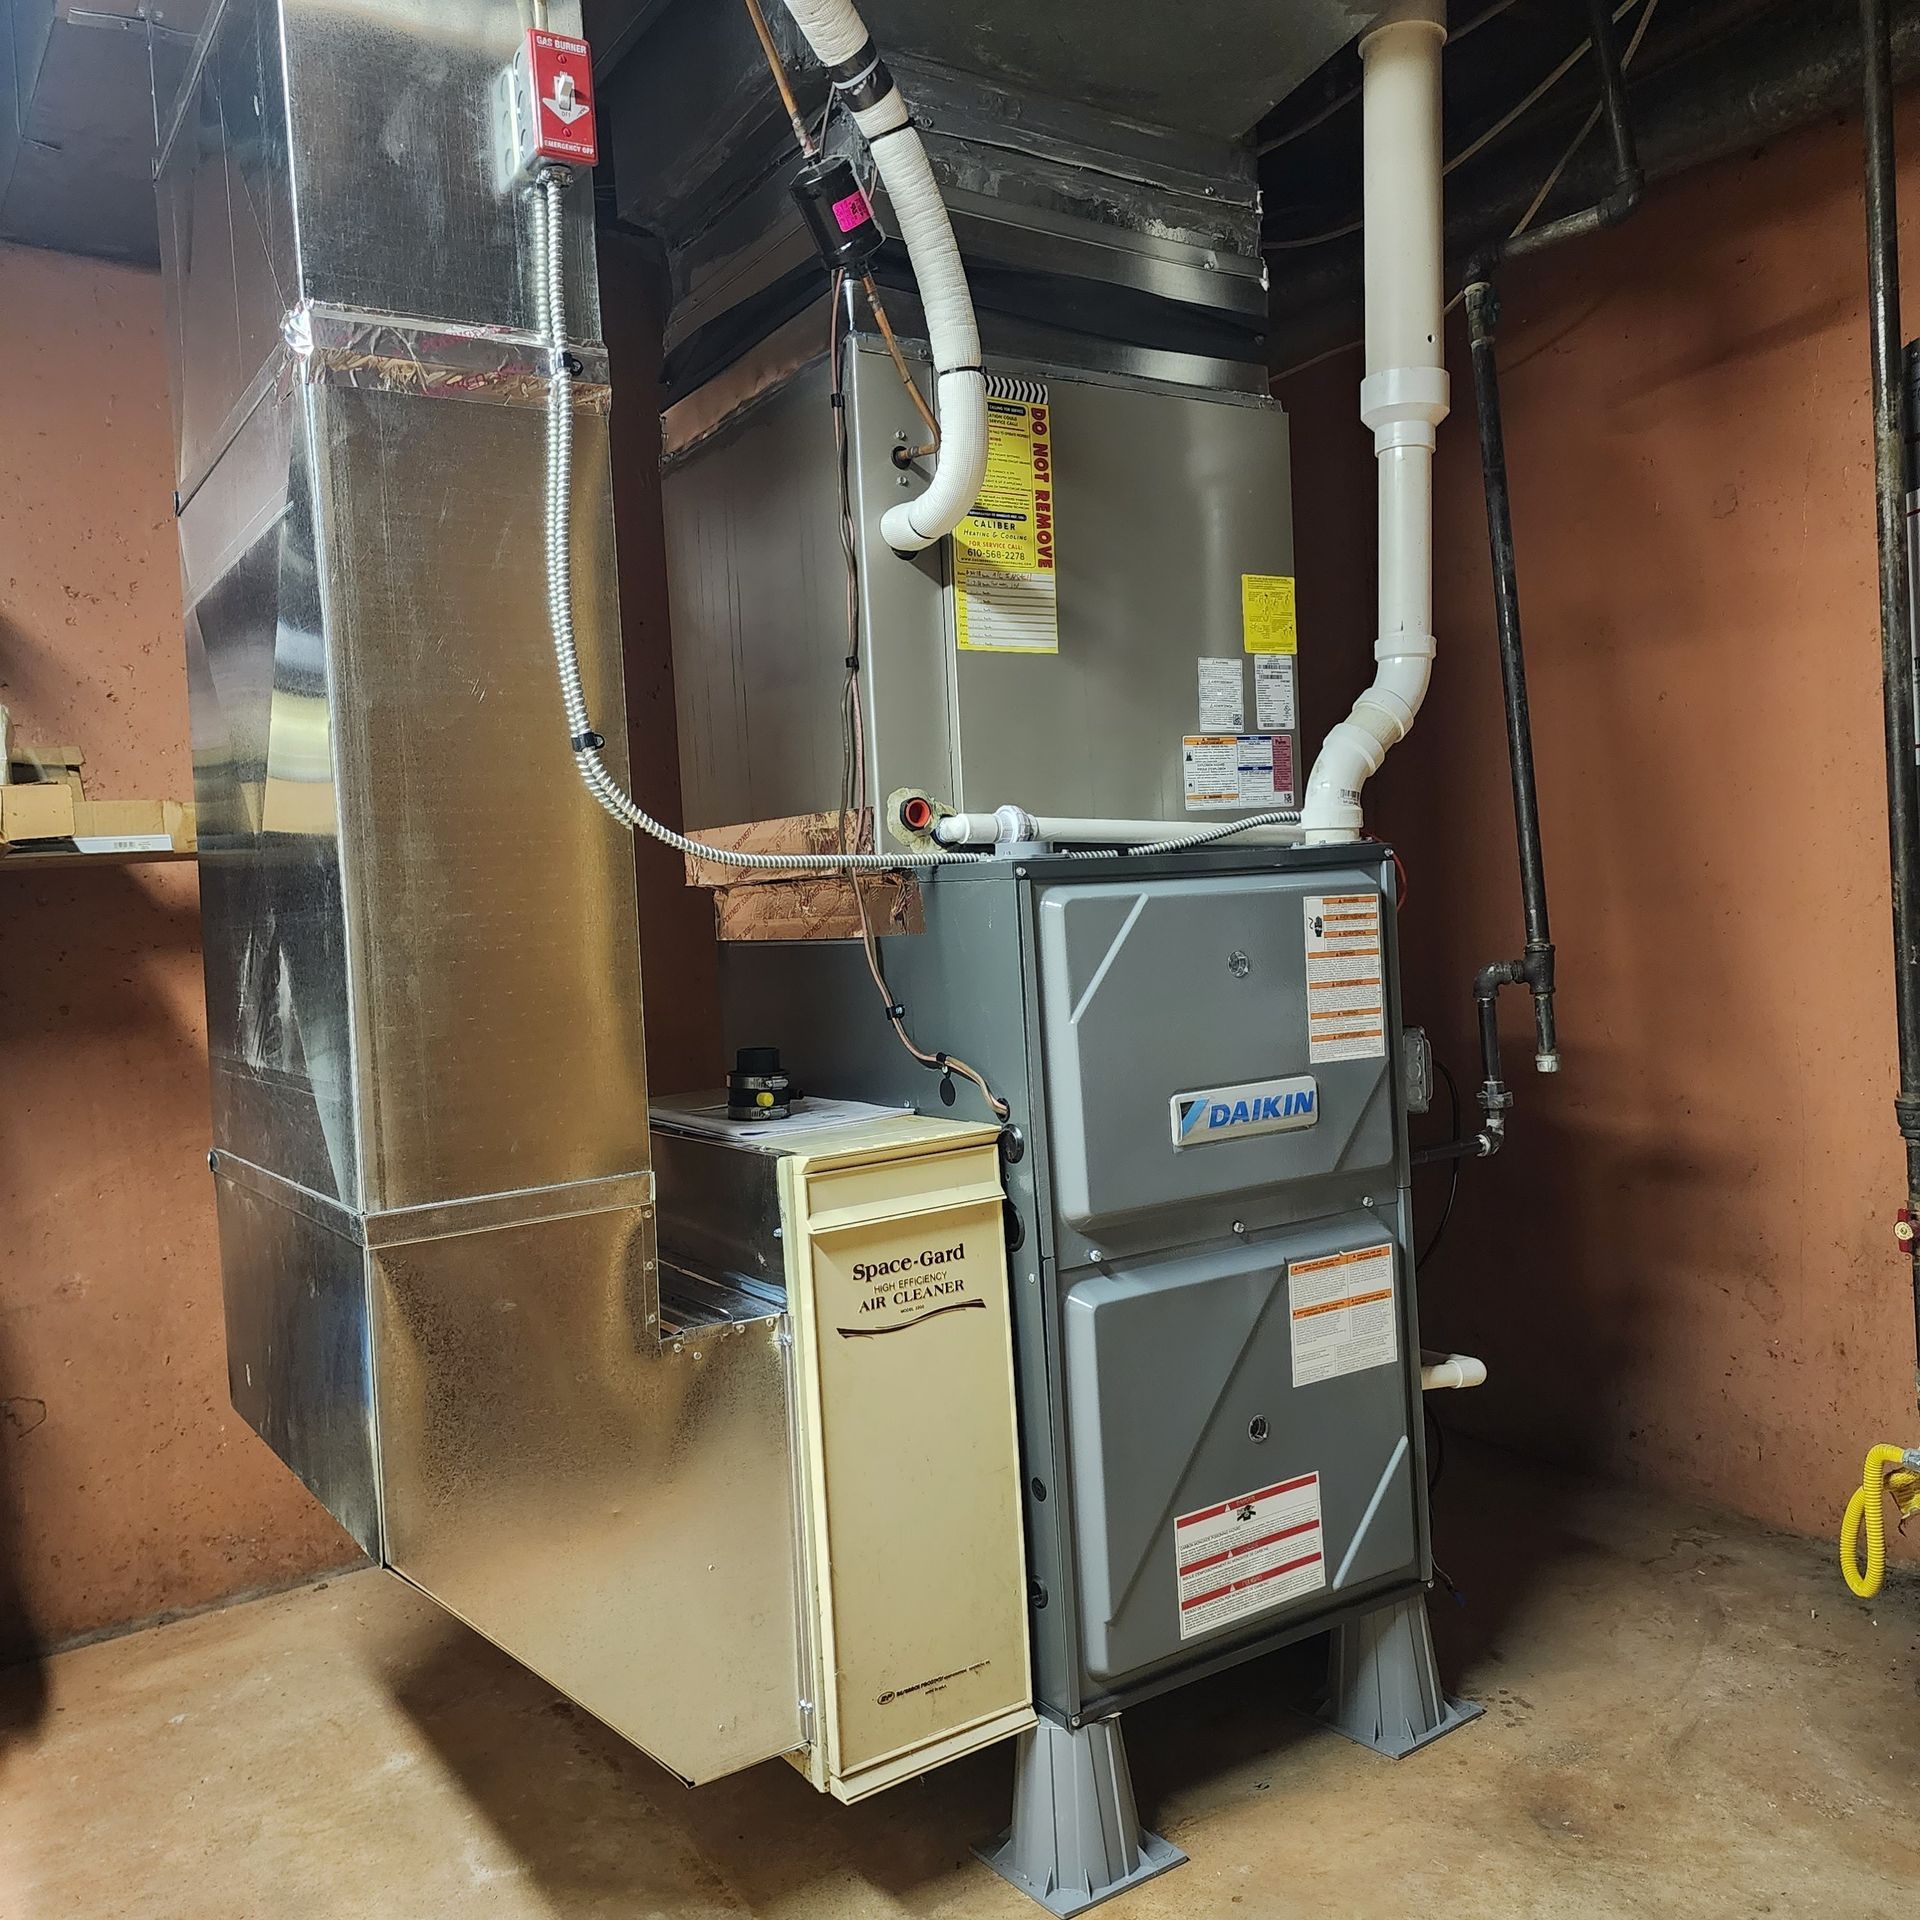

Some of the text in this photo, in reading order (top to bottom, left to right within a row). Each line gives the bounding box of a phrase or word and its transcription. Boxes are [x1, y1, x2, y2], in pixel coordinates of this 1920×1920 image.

[536, 35, 587, 54] GAS BURNER
[544, 140, 594, 155] EMERGENCY OFF
[1031, 407, 1053, 569] DO NOT REMOVE
[973, 519, 1016, 531] CALIBER
[967, 548, 1025, 561] 610-568-2278
[982, 541, 1005, 549] SERVICE
[1208, 1091, 1314, 1128] DAIKIN
[853, 1243, 965, 1282] Space-Gard
[874, 1271, 948, 1294] HIGH EFFICIENCY
[858, 1279, 965, 1314] AIR CLEANER
